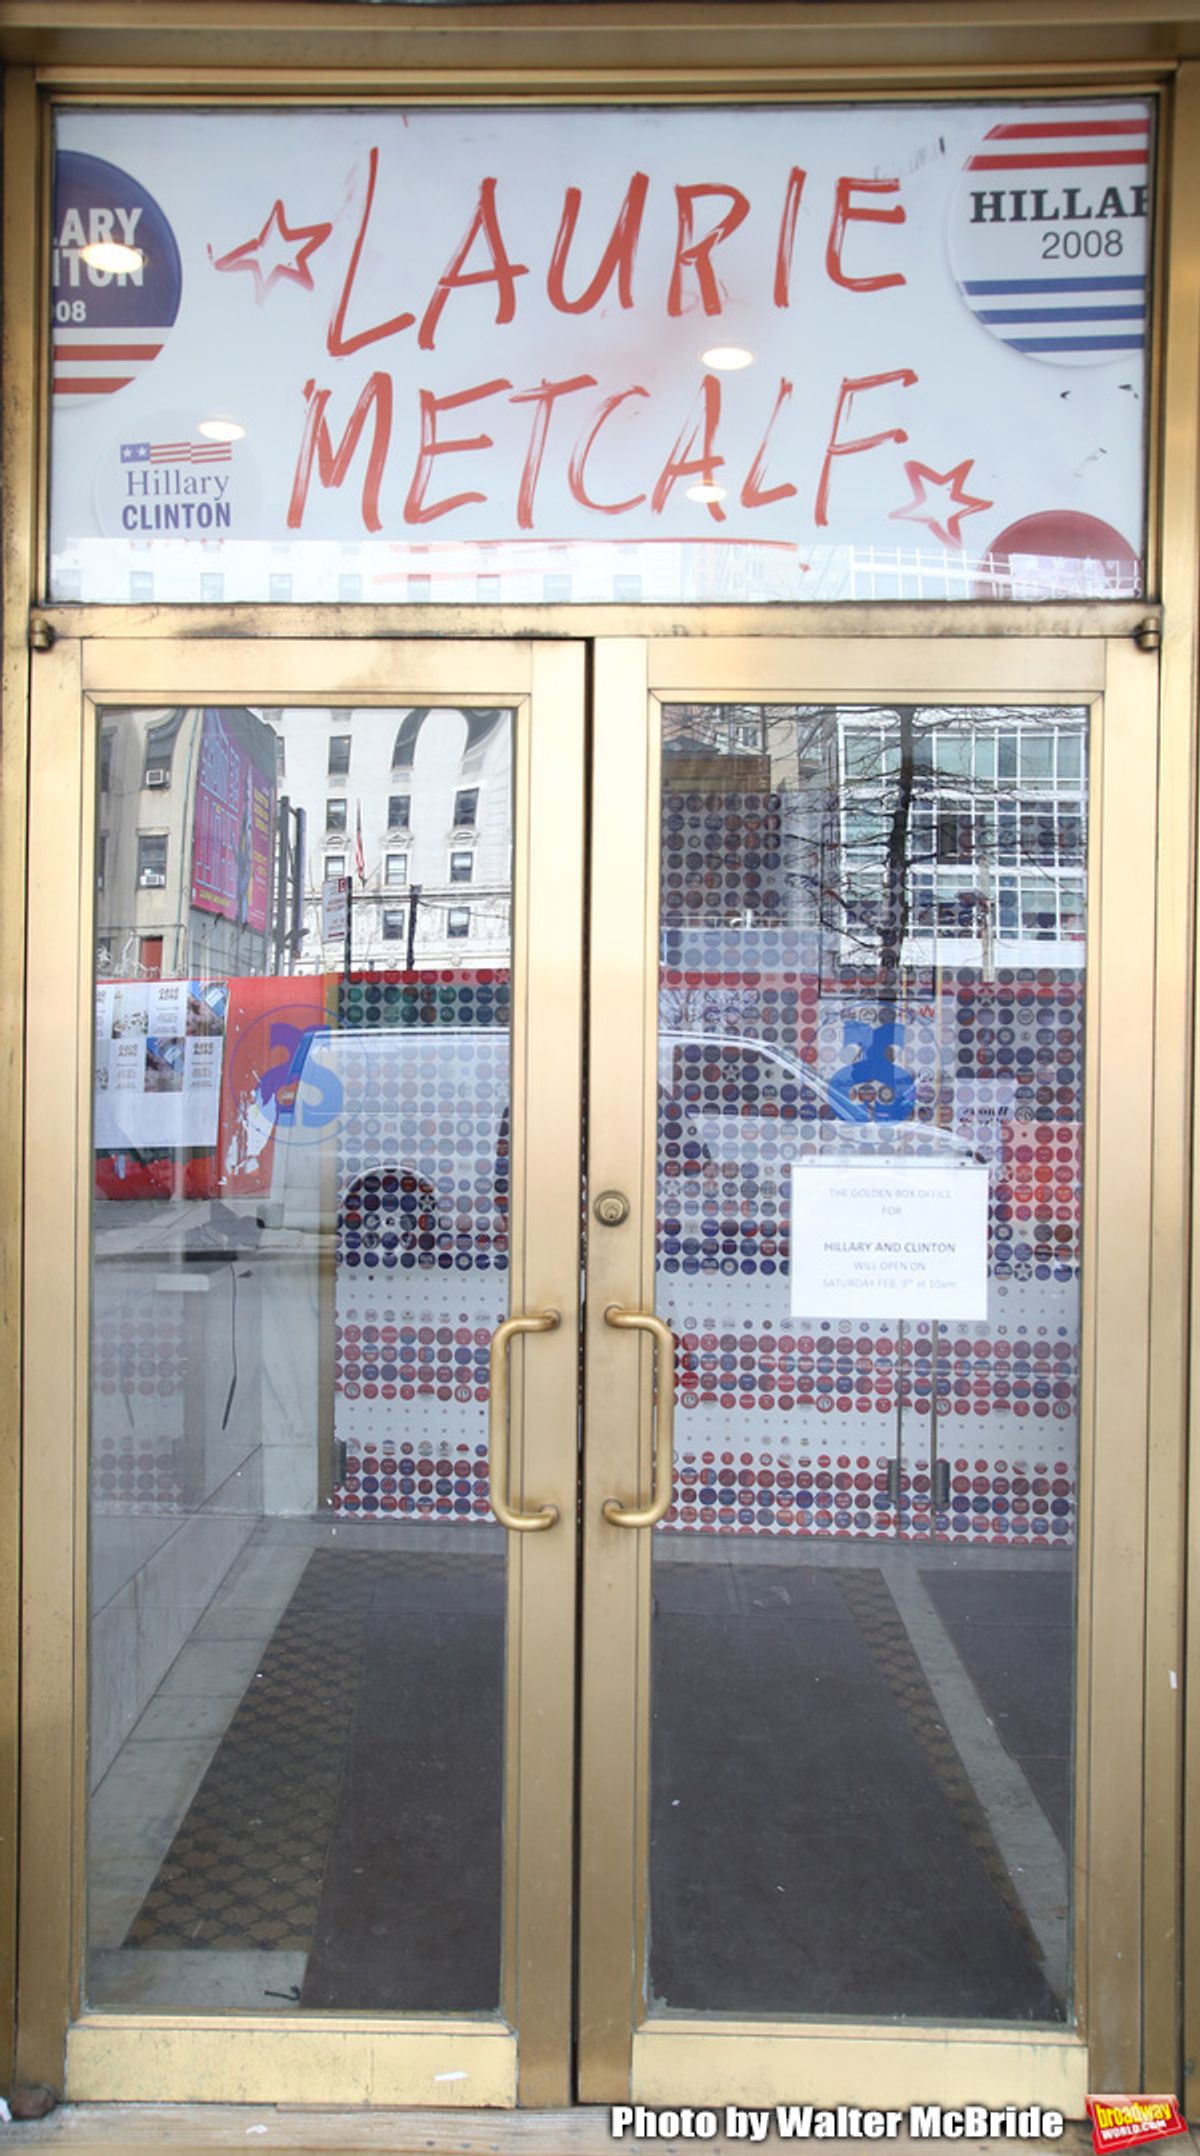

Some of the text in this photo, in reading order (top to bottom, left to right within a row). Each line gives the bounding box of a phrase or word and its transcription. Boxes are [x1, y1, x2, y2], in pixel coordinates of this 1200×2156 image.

[53, 207, 143, 247] ARY
[324, 146, 907, 358] LAURIE
[1041, 228, 1124, 260] 2008
[286, 368, 919, 533] METCALF
[126, 469, 230, 501] Hillary
[122, 502, 231, 530] CLINTON
[829, 1187, 848, 1199] THE
[850, 1187, 893, 1199] GOLDEN
[895, 1187, 916, 1199] BOX
[881, 1206, 903, 1216] FOR
[824, 1242, 956, 1252] HILLARY AND CLINTON
[853, 1260, 926, 1271] WILL OPEN ON
[822, 1278, 875, 1289] SATURDAY
